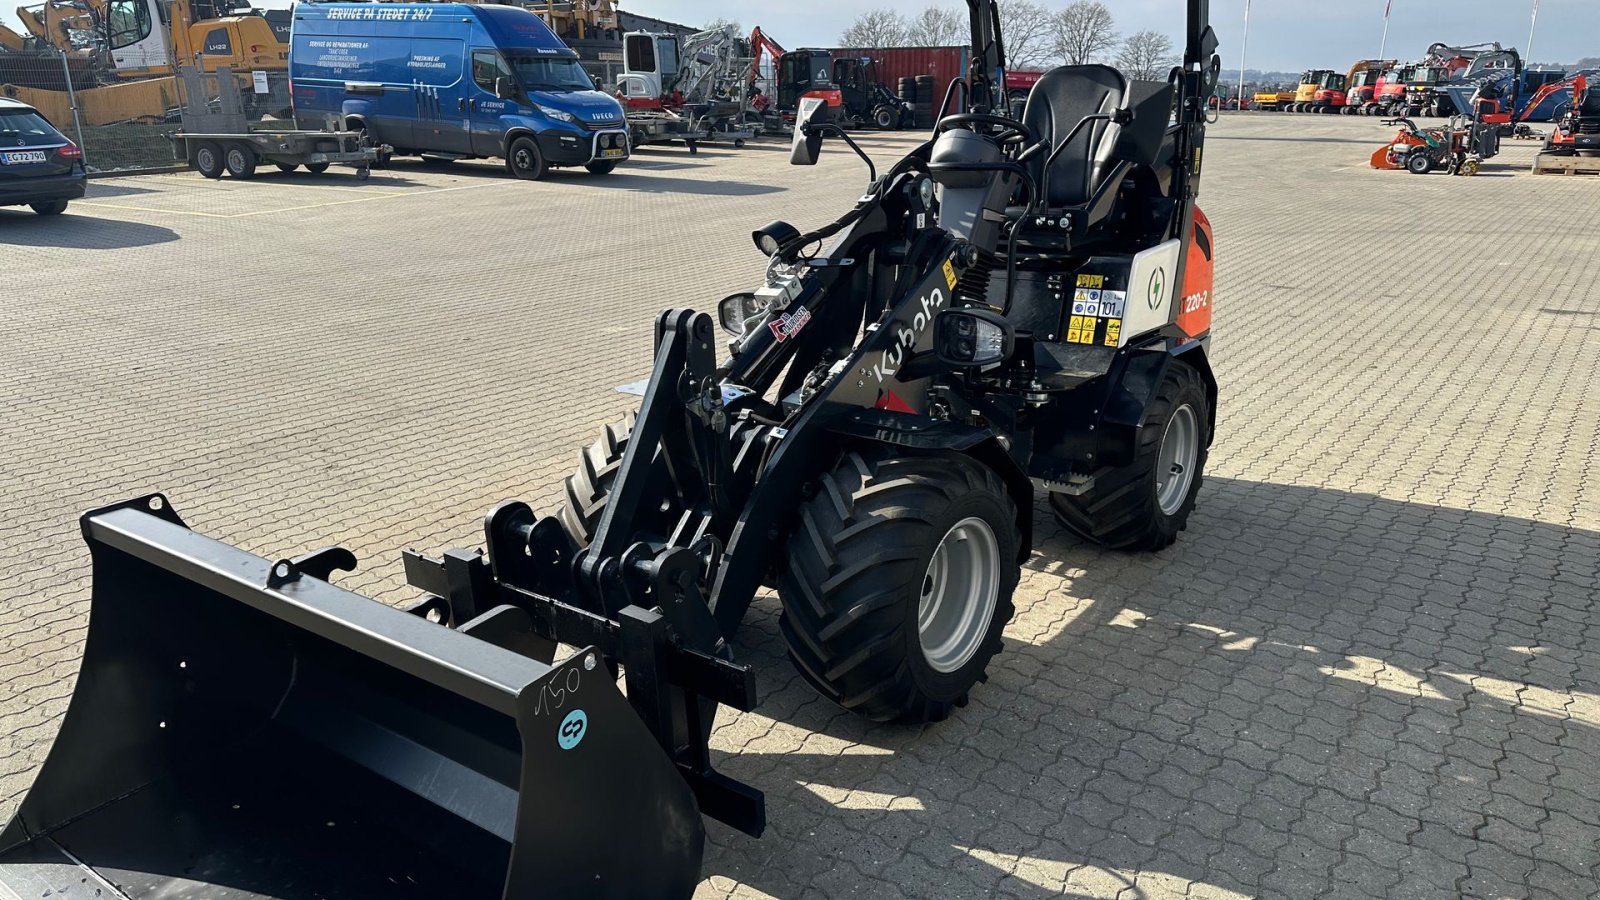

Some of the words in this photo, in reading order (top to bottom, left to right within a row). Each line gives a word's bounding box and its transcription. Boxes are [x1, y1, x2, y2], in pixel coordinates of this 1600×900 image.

[327, 8, 362, 20] SERVICE
[364, 6, 374, 19] PÅ
[376, 8, 409, 20] STEDET
[411, 8, 433, 21] 24/7
[592, 112, 614, 120] IVECO
[1102, 301, 1116, 316] 101
[873, 287, 944, 383] Kubota
[535, 667, 580, 716] 150
